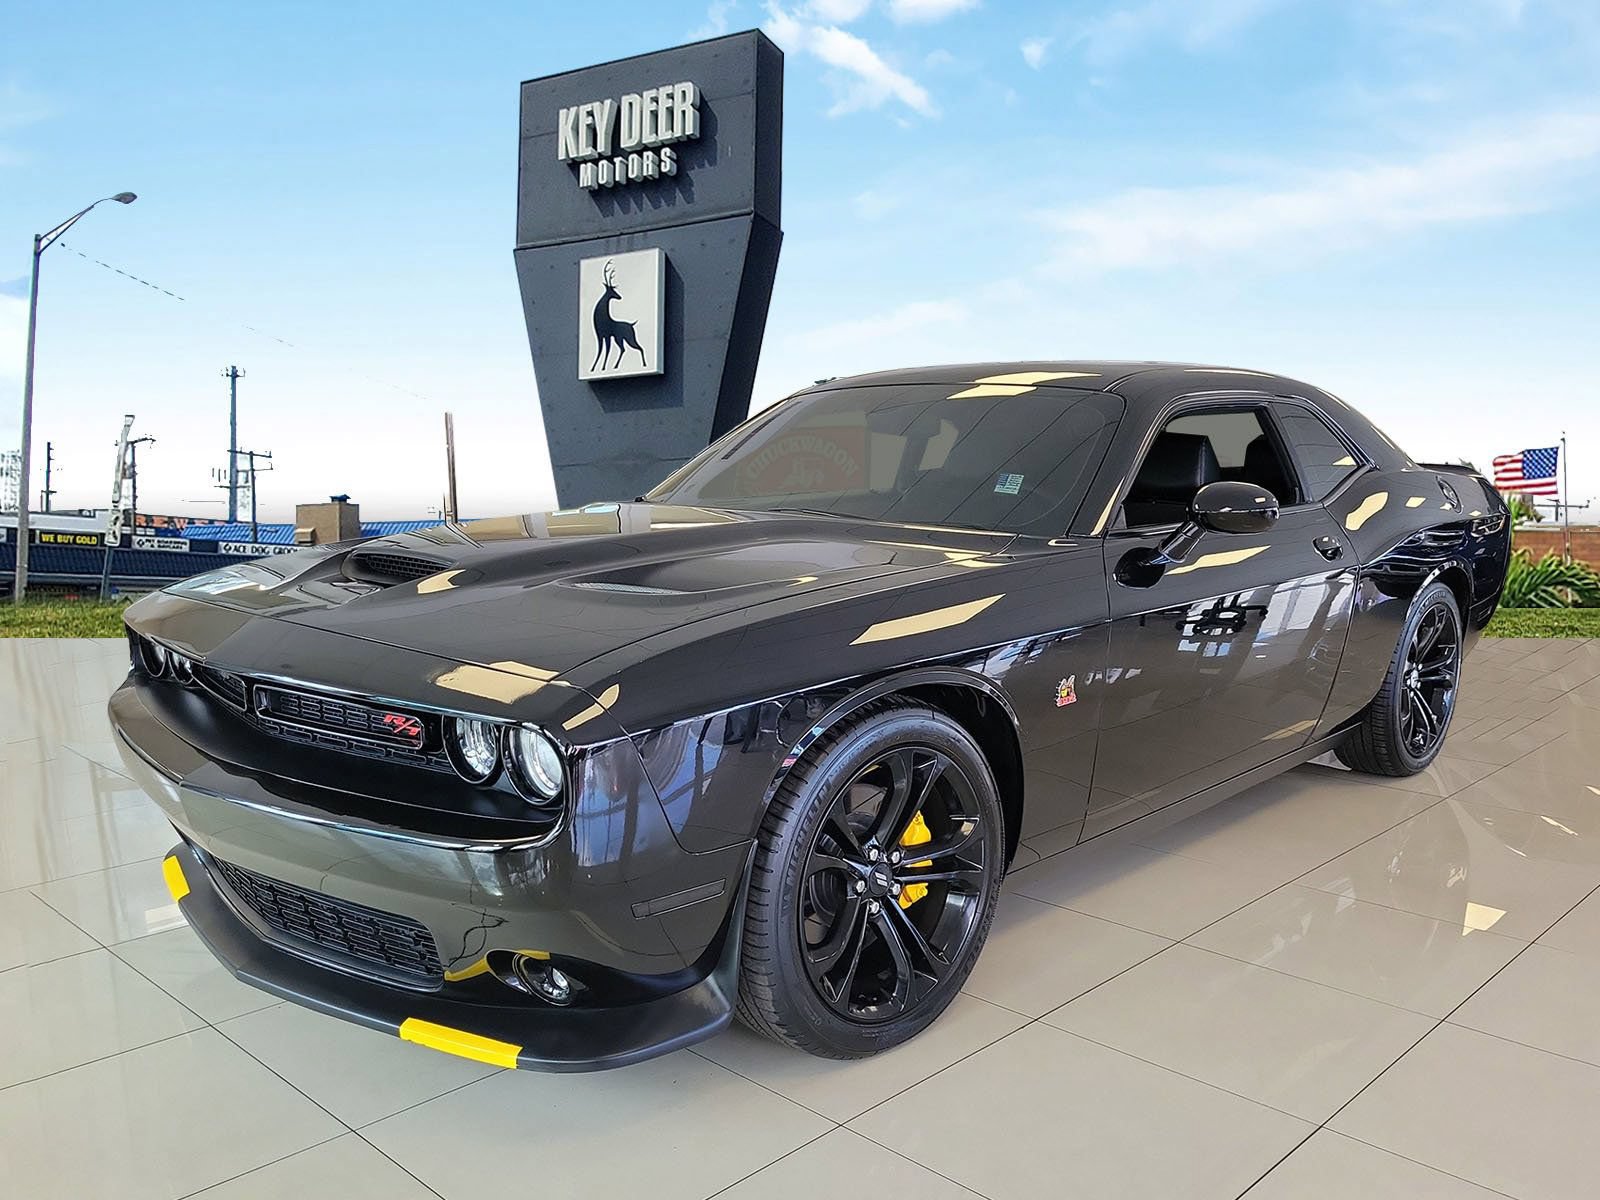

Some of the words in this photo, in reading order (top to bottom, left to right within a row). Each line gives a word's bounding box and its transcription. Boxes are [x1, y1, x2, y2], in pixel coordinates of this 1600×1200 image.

[558, 98, 617, 162] KEY
[620, 81, 701, 153] DEER
[579, 147, 677, 191] MOTORS
[41, 533, 55, 543] WE
[57, 534, 74, 544] BUY
[76, 535, 98, 545] GOLD
[233, 545, 247, 553] ACE
[251, 546, 270, 555] DOG
[785, 776, 832, 887] MICHELIN
